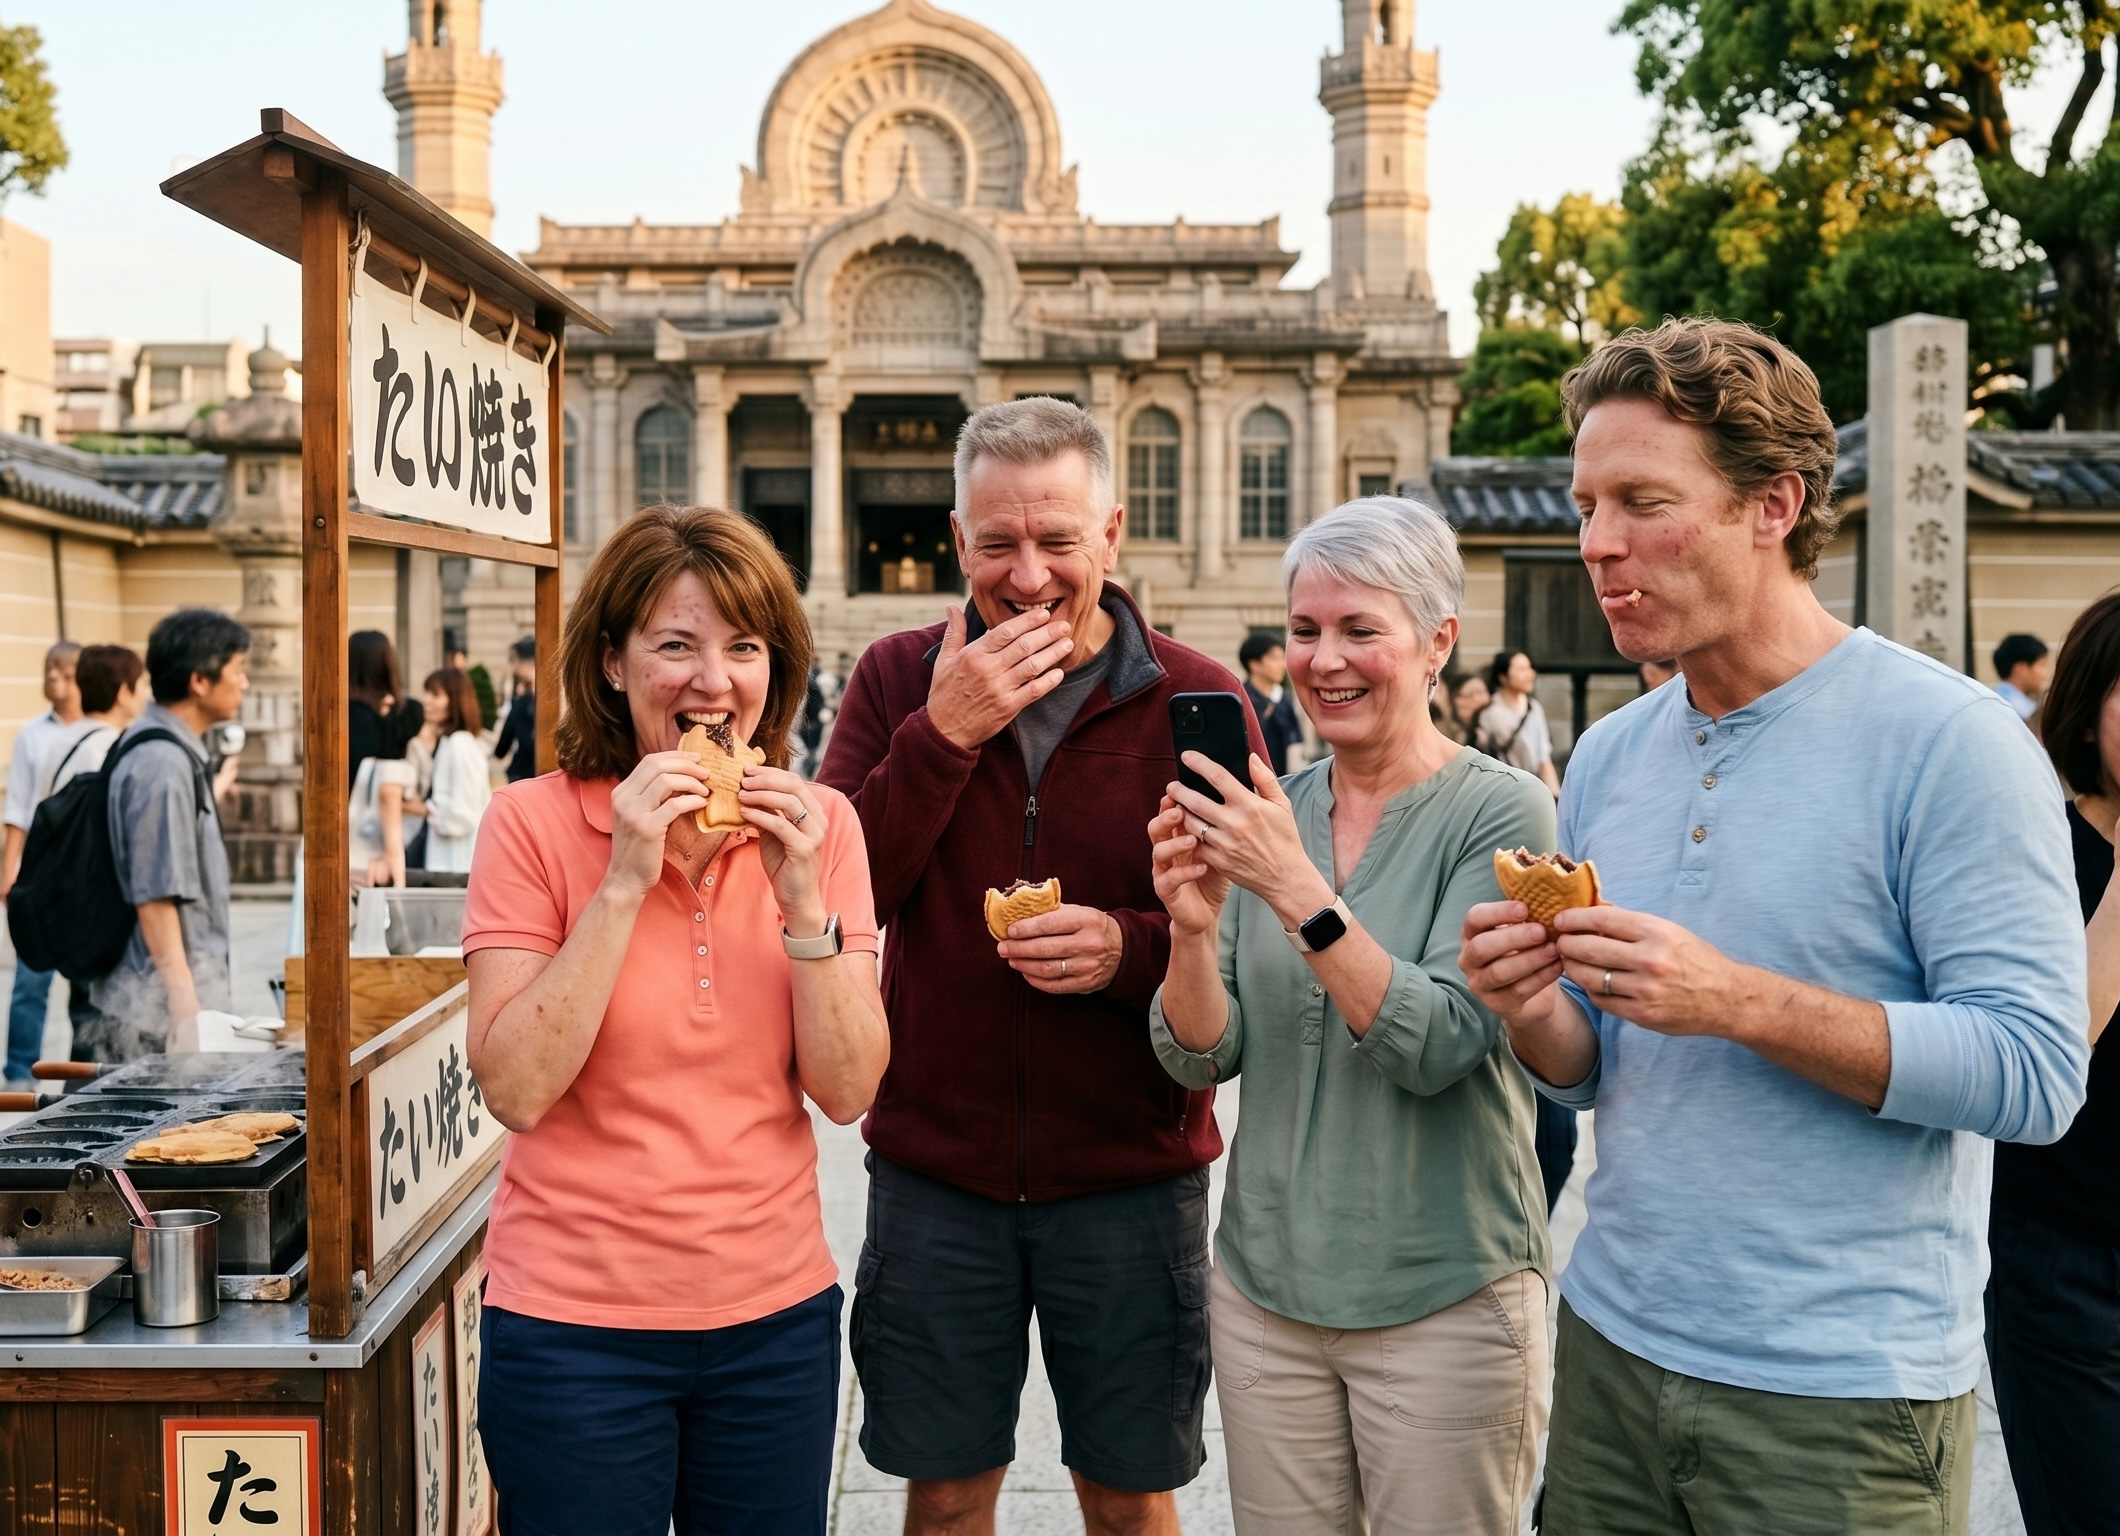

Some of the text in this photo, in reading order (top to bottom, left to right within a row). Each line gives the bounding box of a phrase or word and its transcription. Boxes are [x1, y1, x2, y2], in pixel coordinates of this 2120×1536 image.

[373, 322, 537, 516] たい焼き
[379, 1043, 481, 1221] たい焼き
[206, 1449, 279, 1536] た
